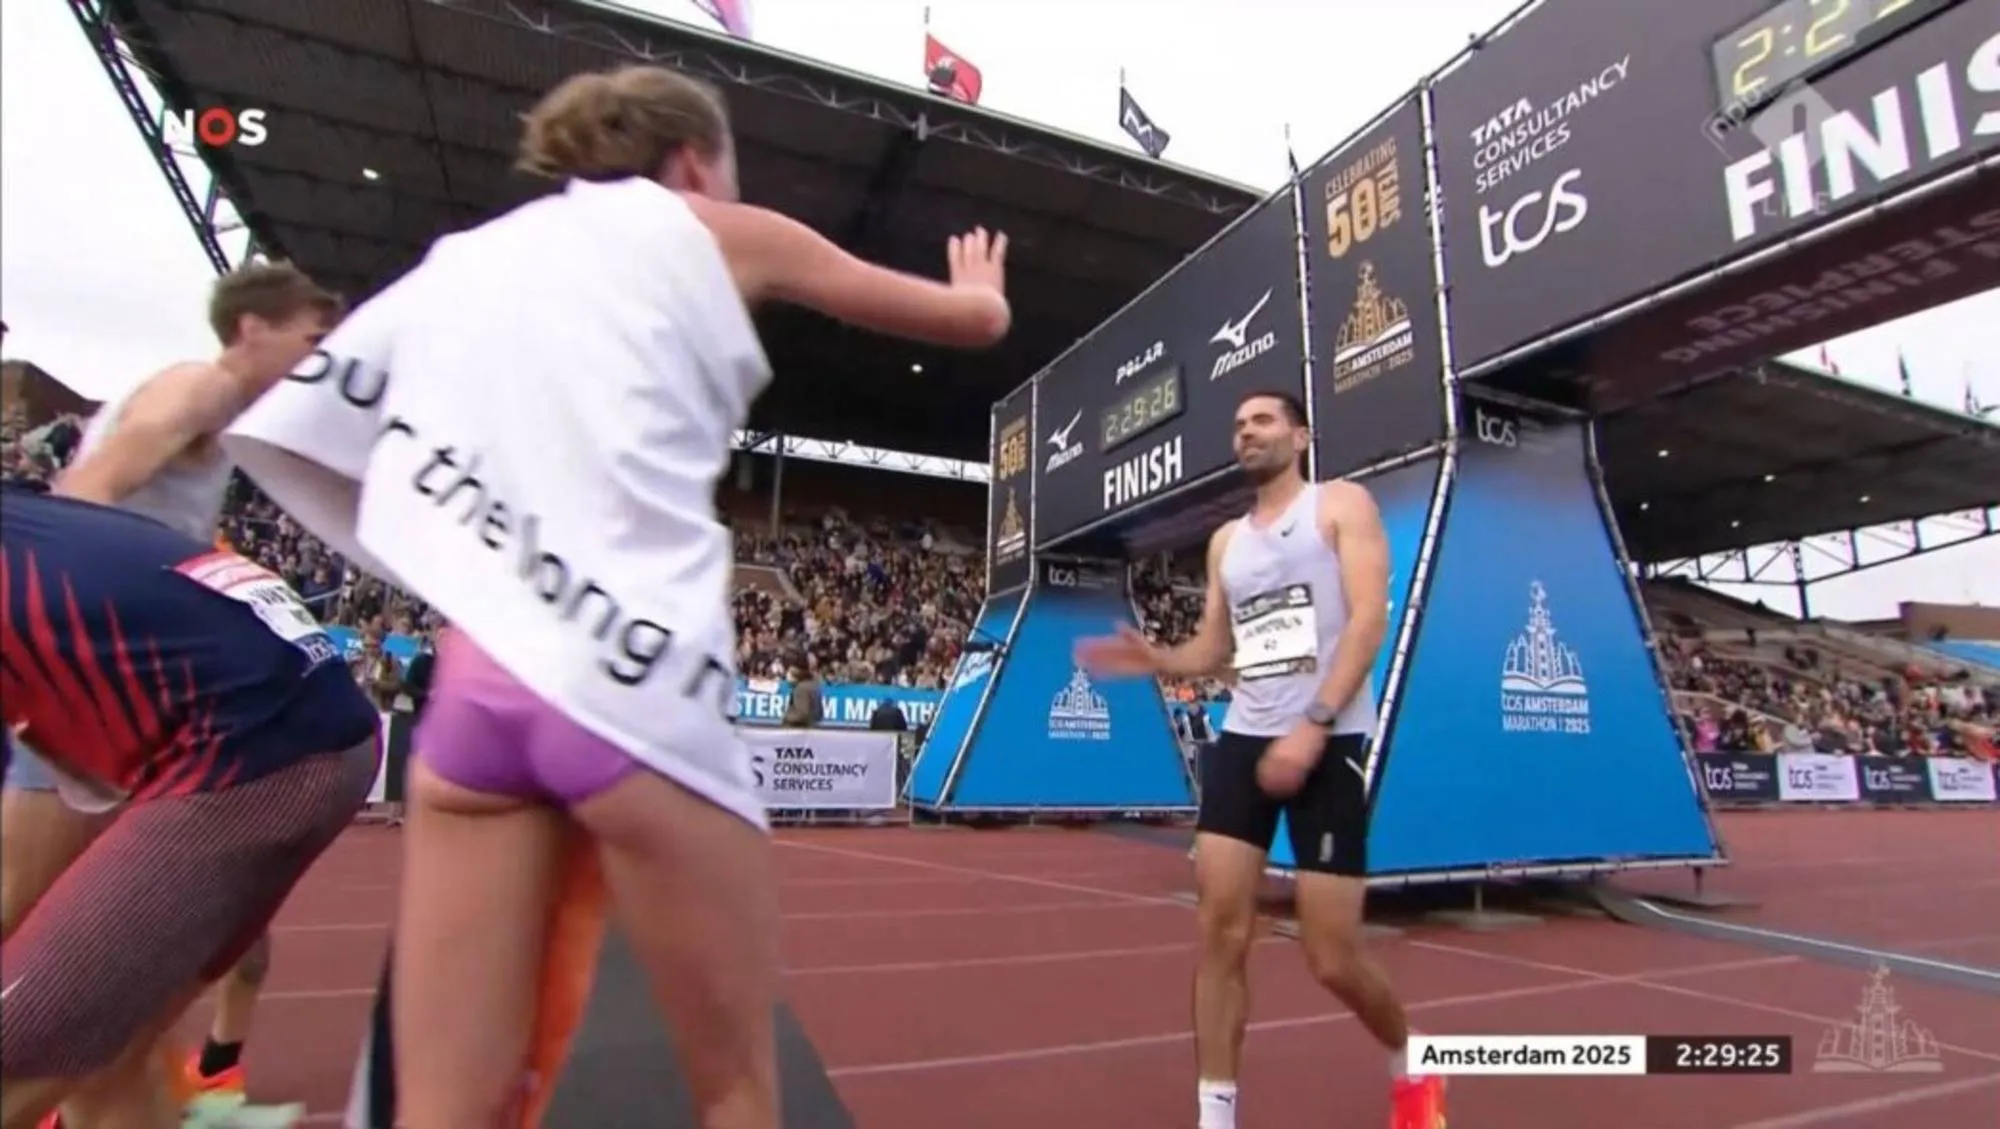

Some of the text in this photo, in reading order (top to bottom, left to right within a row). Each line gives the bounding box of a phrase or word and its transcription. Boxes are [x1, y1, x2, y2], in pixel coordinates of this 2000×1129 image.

[1470, 97, 1532, 146] TATA
[1474, 53, 1630, 169] CONSULTANCY
[1325, 137, 1397, 200] CELEBRATING
[1476, 121, 1571, 193] SERVICES
[1327, 178, 1377, 258] 50
[1115, 341, 1164, 385] POLAR
[1351, 331, 1412, 370] AMSTERDAM
[1105, 377, 1175, 444] 2:29:26
[1103, 436, 1182, 510] FINISH
[413, 446, 510, 551] the
[518, 514, 675, 686] long
[1503, 714, 1590, 734] MARATHON 2025
[1525, 695, 1588, 714] AMSTERDAM
[773, 748, 814, 760] TATA
[773, 762, 868, 777] CONSULTANCY
[773, 778, 833, 791] SERVICES
